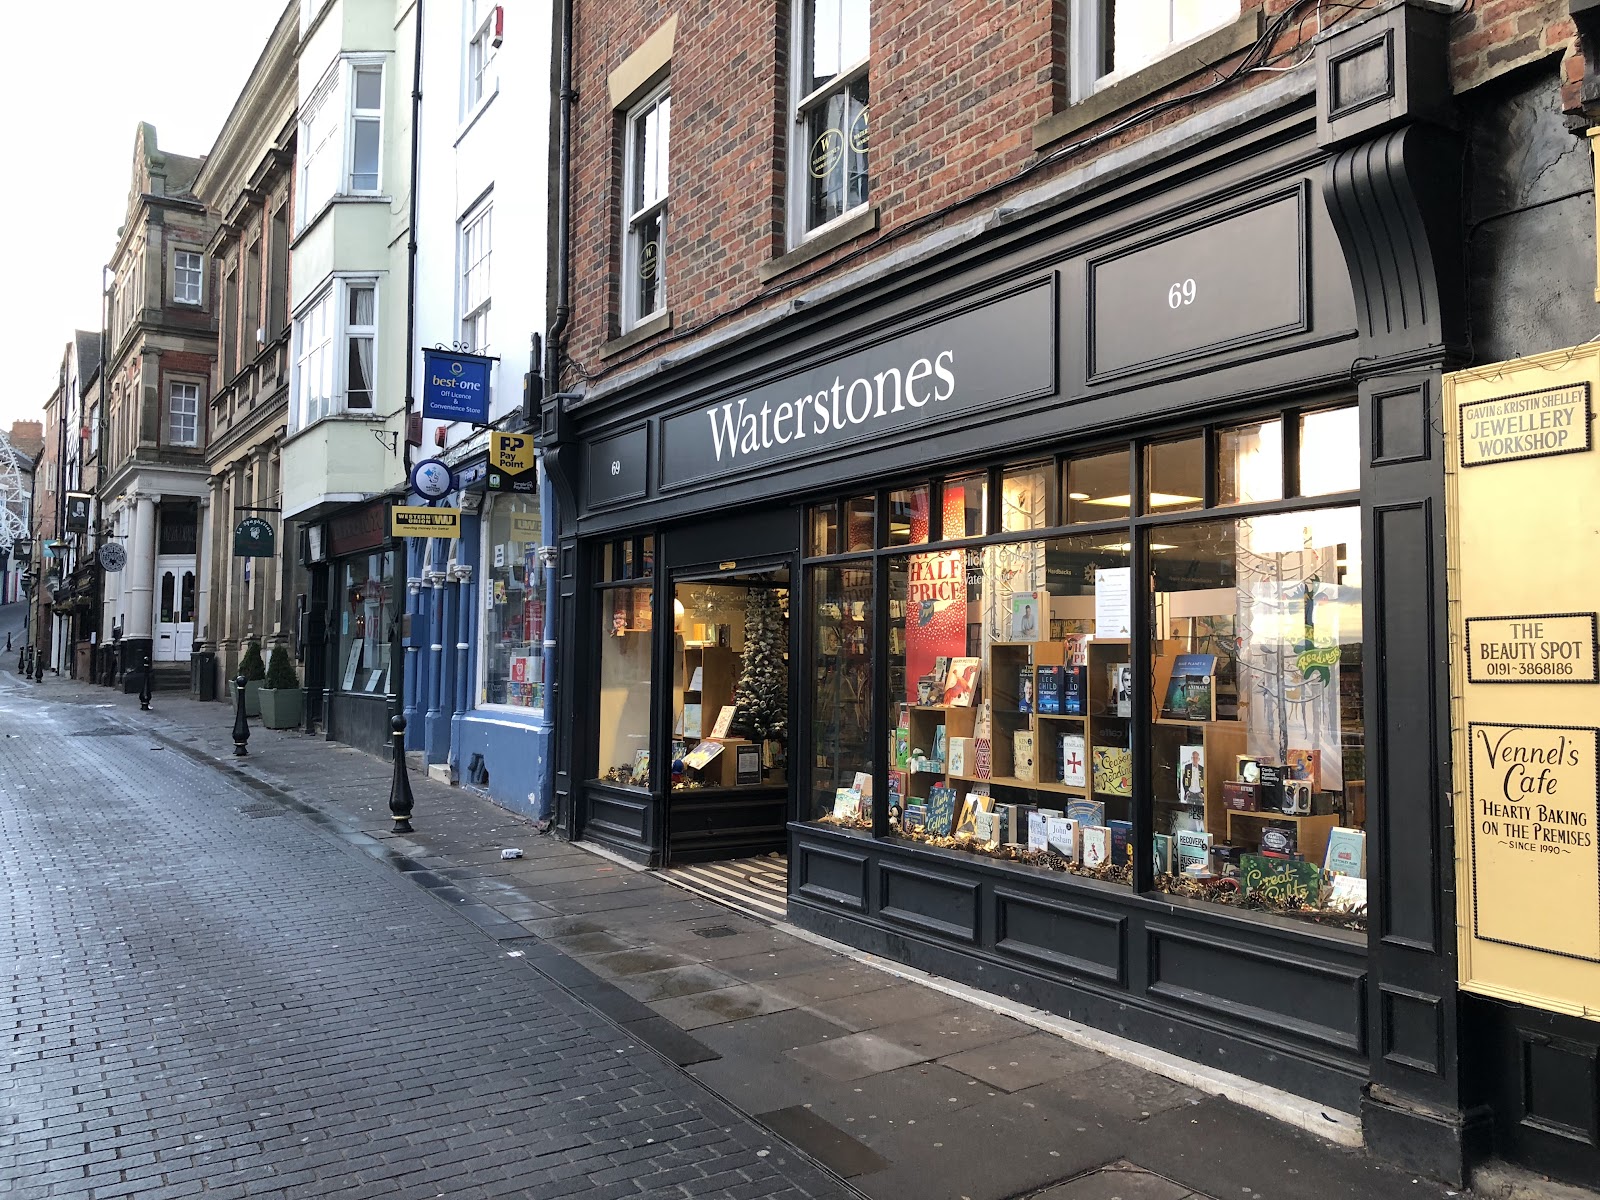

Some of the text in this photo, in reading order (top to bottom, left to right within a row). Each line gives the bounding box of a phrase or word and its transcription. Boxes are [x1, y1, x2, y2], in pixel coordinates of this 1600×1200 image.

[1168, 278, 1197, 309] 69
[432, 374, 481, 391] best-one
[451, 391, 472, 400] Licence
[706, 349, 956, 462] Waterstones
[1466, 390, 1584, 421] GAVIN & KRISTIN SHELLEY
[430, 401, 481, 414] Convenience Store
[1470, 406, 1575, 440] JEWELLERY
[1478, 429, 1569, 458] WORKSHOP
[500, 452, 516, 461] Pay
[500, 460, 524, 469] Point
[611, 460, 621, 476] 69
[910, 559, 961, 582] HALF
[909, 580, 961, 603] PRICE
[1509, 622, 1544, 640] THE
[1480, 641, 1583, 660] BEAUTY SPOT
[1476, 727, 1579, 770] Vennel's
[1503, 763, 1558, 803] Cafe
[1479, 798, 1588, 827] HEARTY BAKING
[1048, 833, 1072, 845] Grisham
[1052, 825, 1067, 835] John
[1179, 835, 1205, 846] RECOVERY
[1482, 820, 1592, 847] ON THE PREMISES
